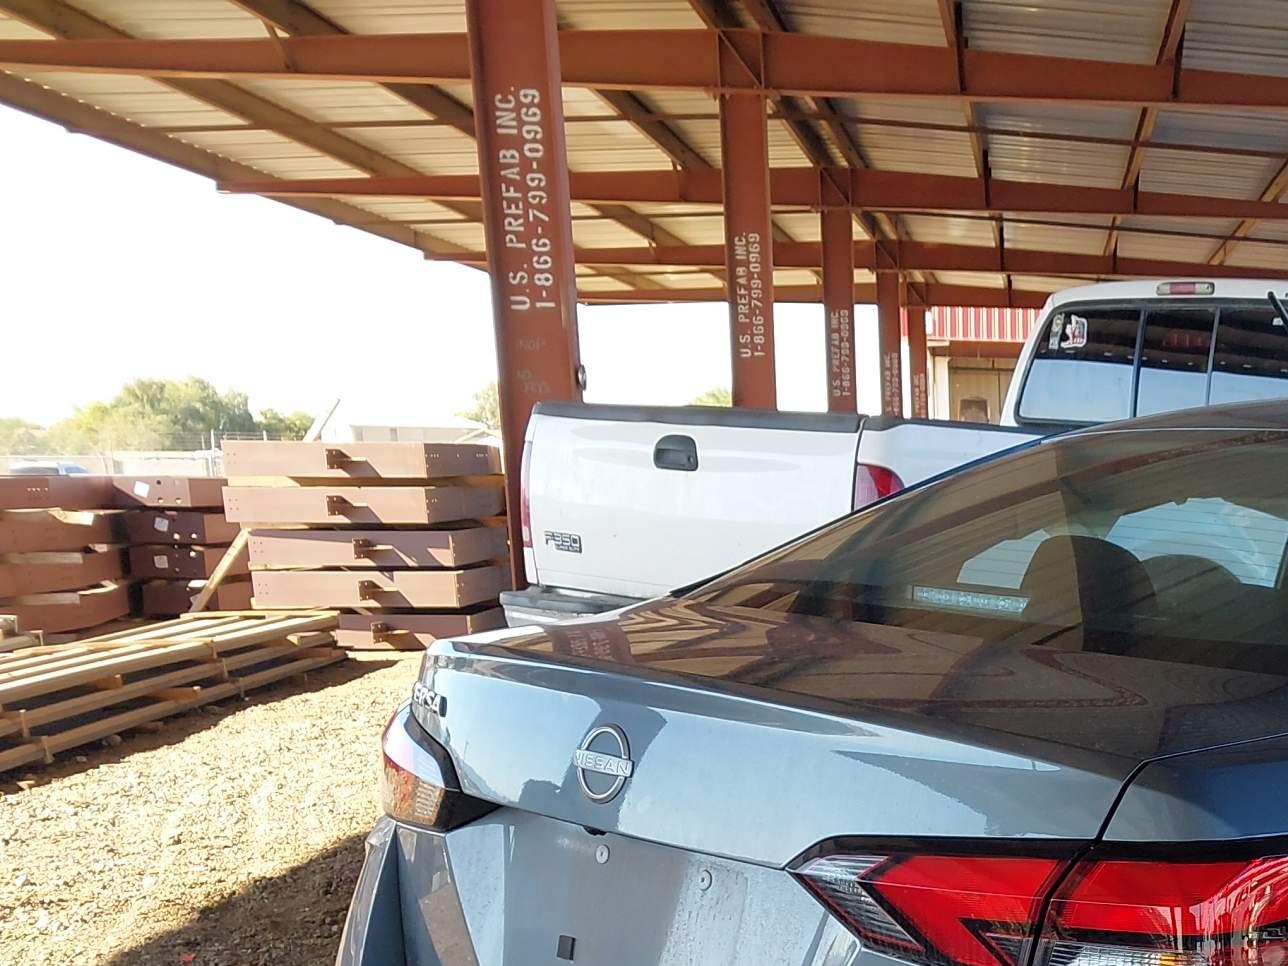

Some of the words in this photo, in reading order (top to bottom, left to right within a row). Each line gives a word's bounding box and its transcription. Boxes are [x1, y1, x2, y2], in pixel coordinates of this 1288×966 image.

[494, 86, 517, 135] INC.
[499, 148, 526, 249] PREFAB
[519, 88, 556, 308] 1-866-799-0969
[734, 231, 746, 260] INC.
[508, 262, 530, 311] U.S.
[735, 266, 750, 322] PREFAB
[748, 232, 765, 356] 1-866-799-0969
[739, 330, 752, 357] U.S.
[576, 749, 630, 775] NISSAN
